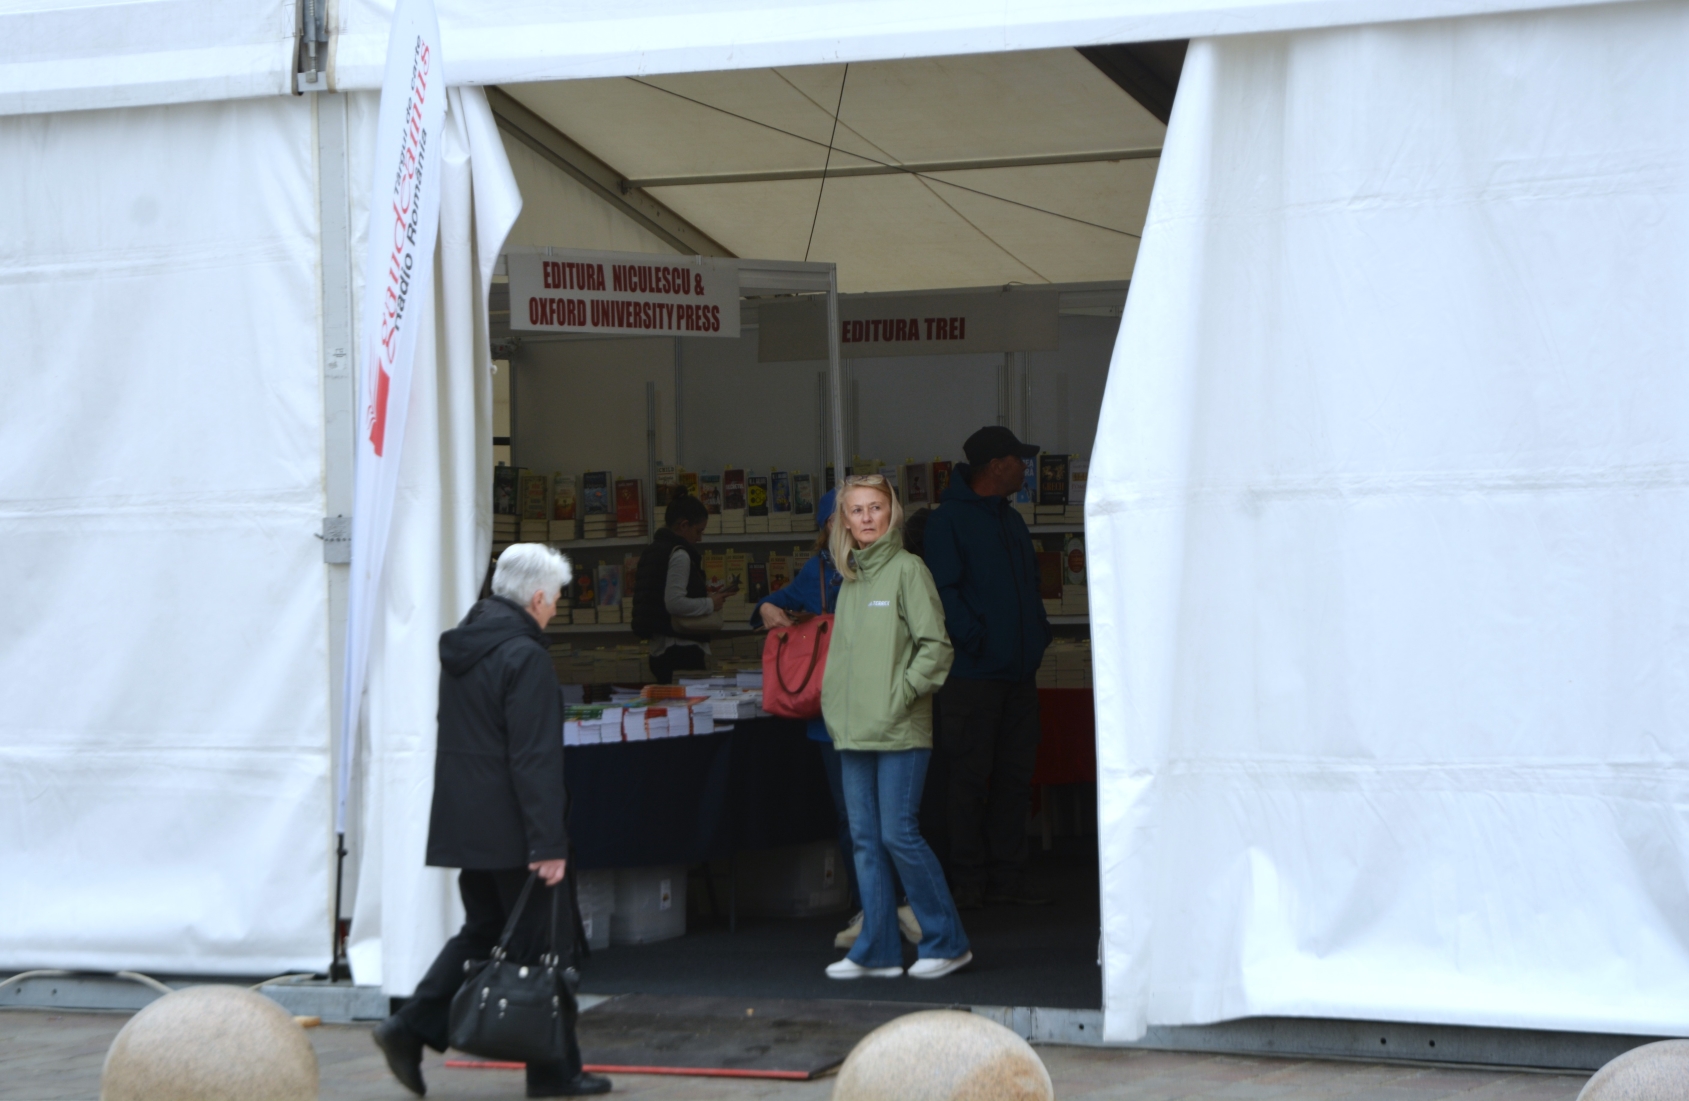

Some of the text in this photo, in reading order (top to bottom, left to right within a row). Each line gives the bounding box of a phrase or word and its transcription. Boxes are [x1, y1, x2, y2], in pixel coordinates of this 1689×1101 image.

[406, 96, 413, 125] de
[410, 34, 422, 91] carte
[382, 39, 431, 364] gaudeamus
[406, 127, 428, 246] România
[542, 261, 705, 296] EDITURA NICULESCU &
[529, 297, 721, 332] OXFORD UNIVERSITY PRESS
[841, 317, 966, 343] EDITURA TREI
